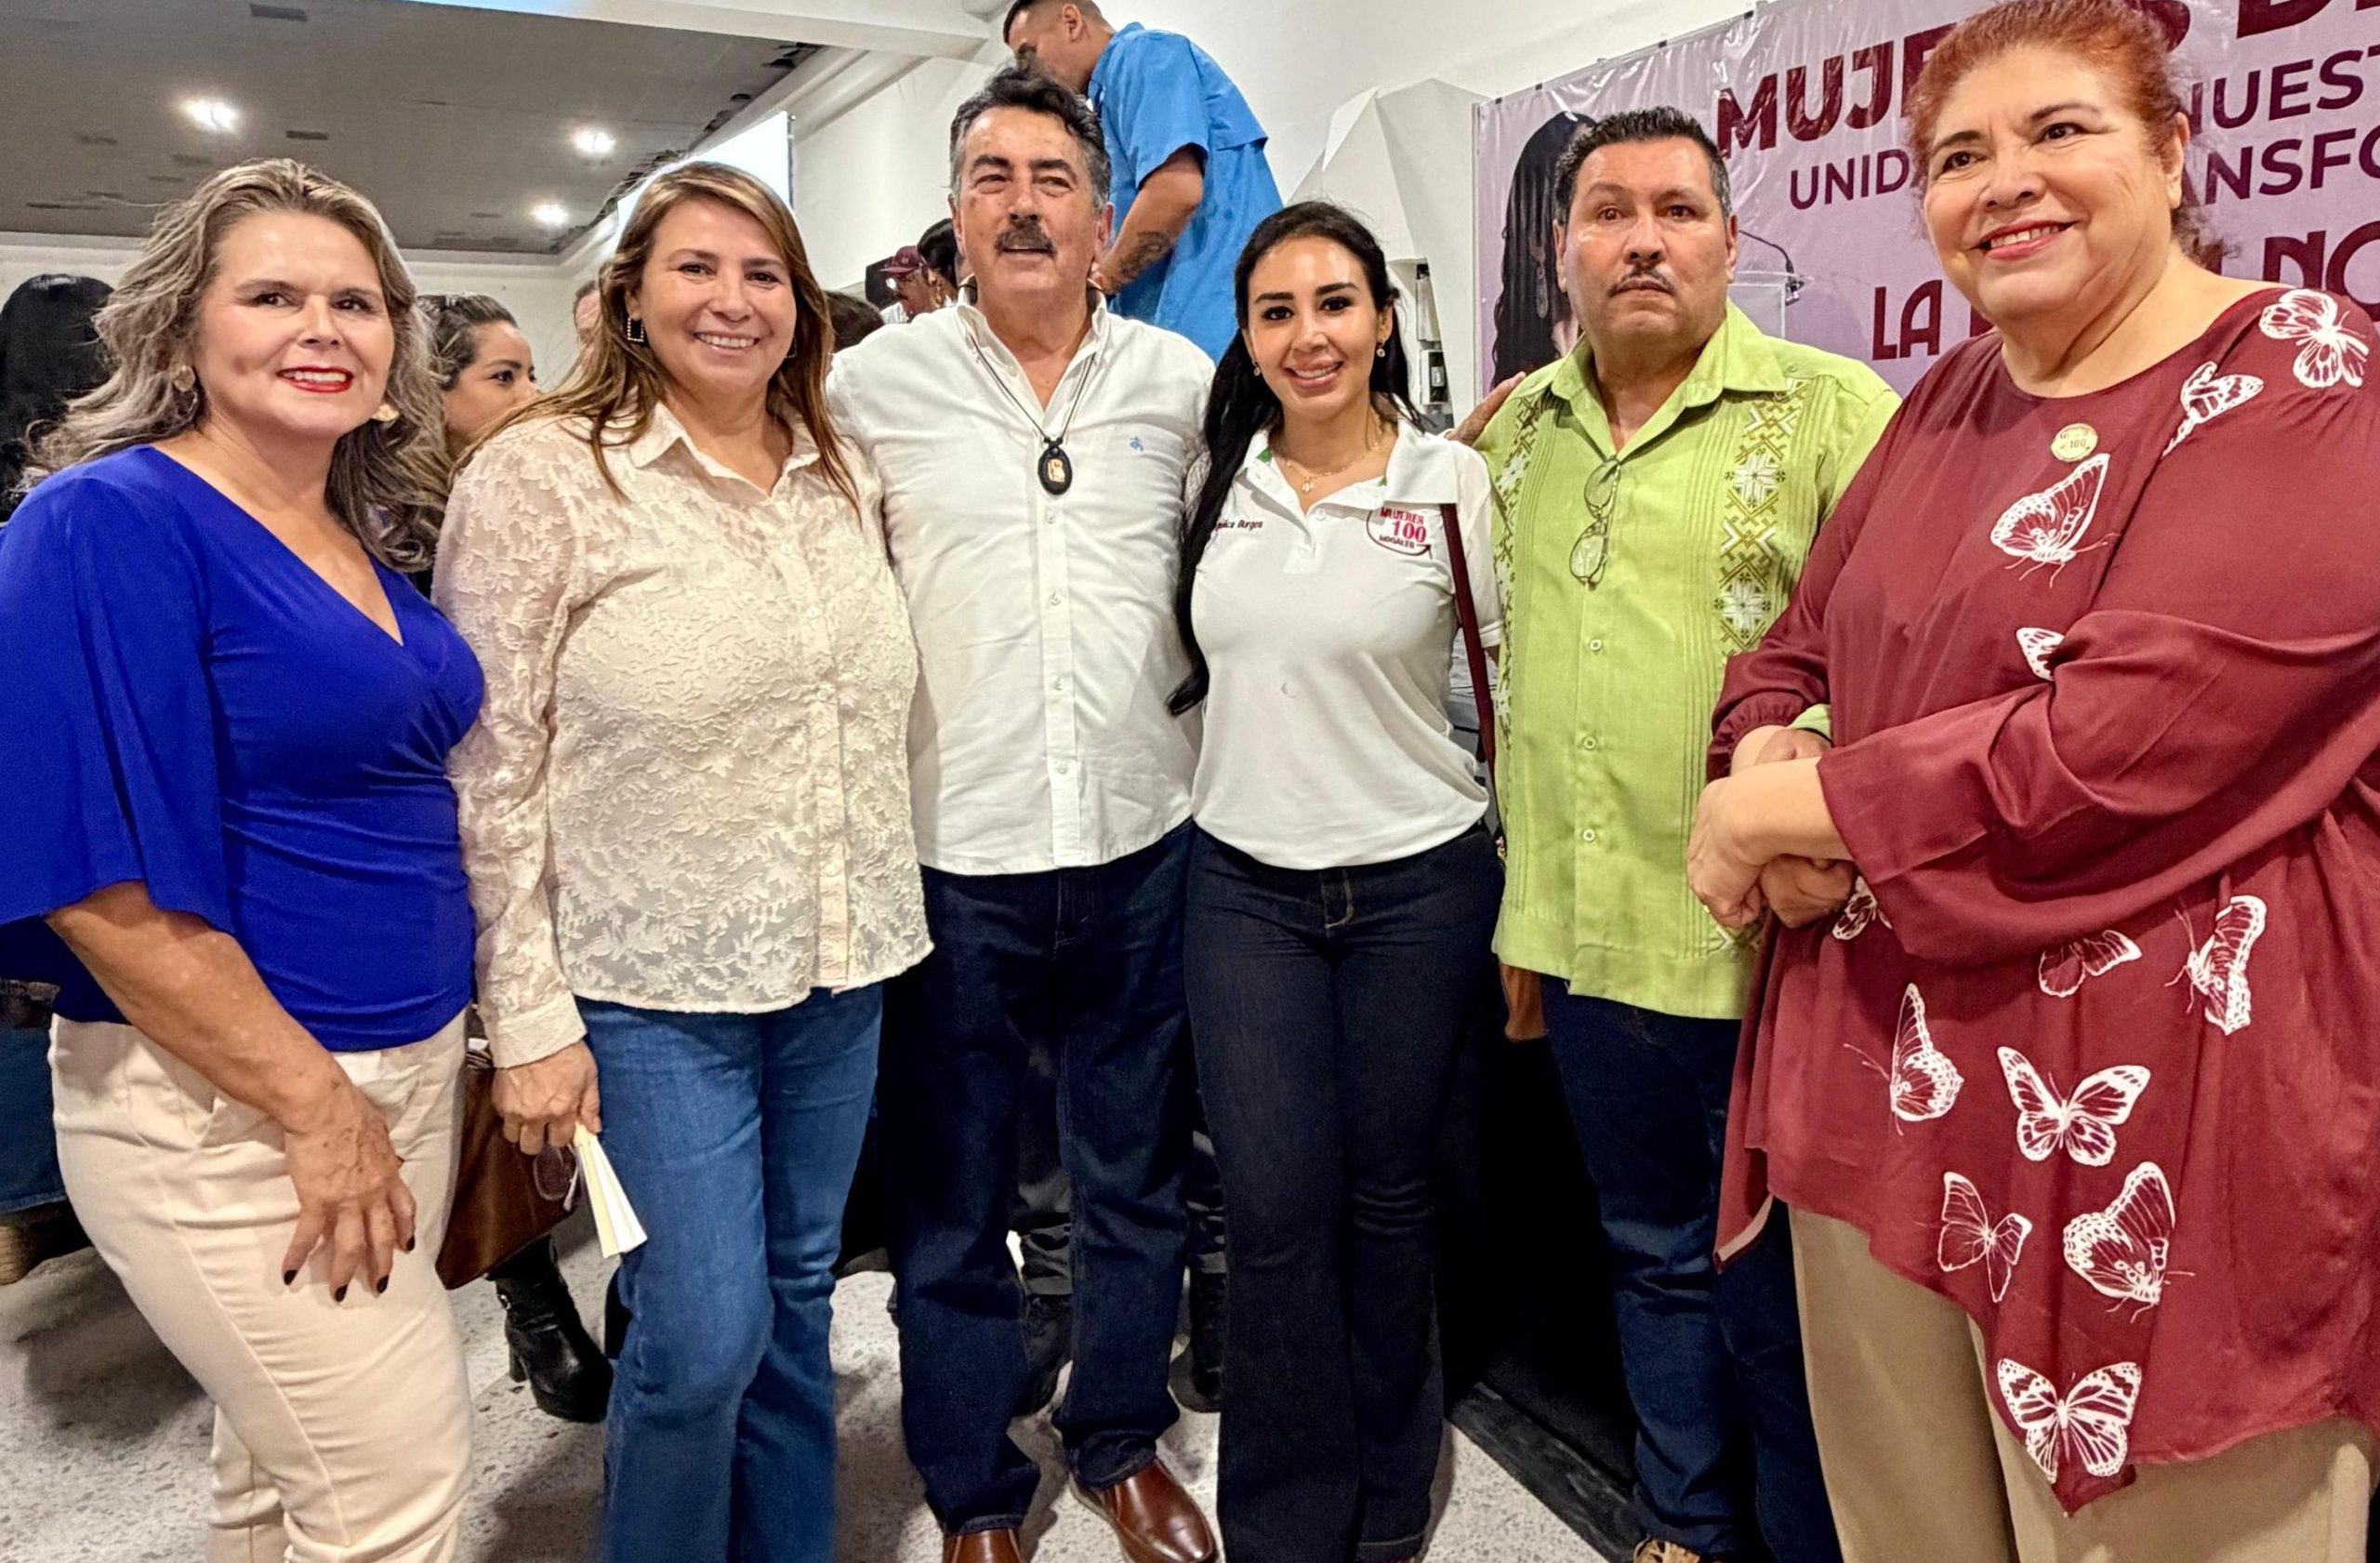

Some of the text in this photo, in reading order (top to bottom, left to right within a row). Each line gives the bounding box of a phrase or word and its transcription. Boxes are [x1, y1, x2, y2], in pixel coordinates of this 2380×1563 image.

[1872, 279, 1943, 360] LA
[1380, 507, 1424, 525] MUJERES
[1393, 521, 1427, 543] 100
